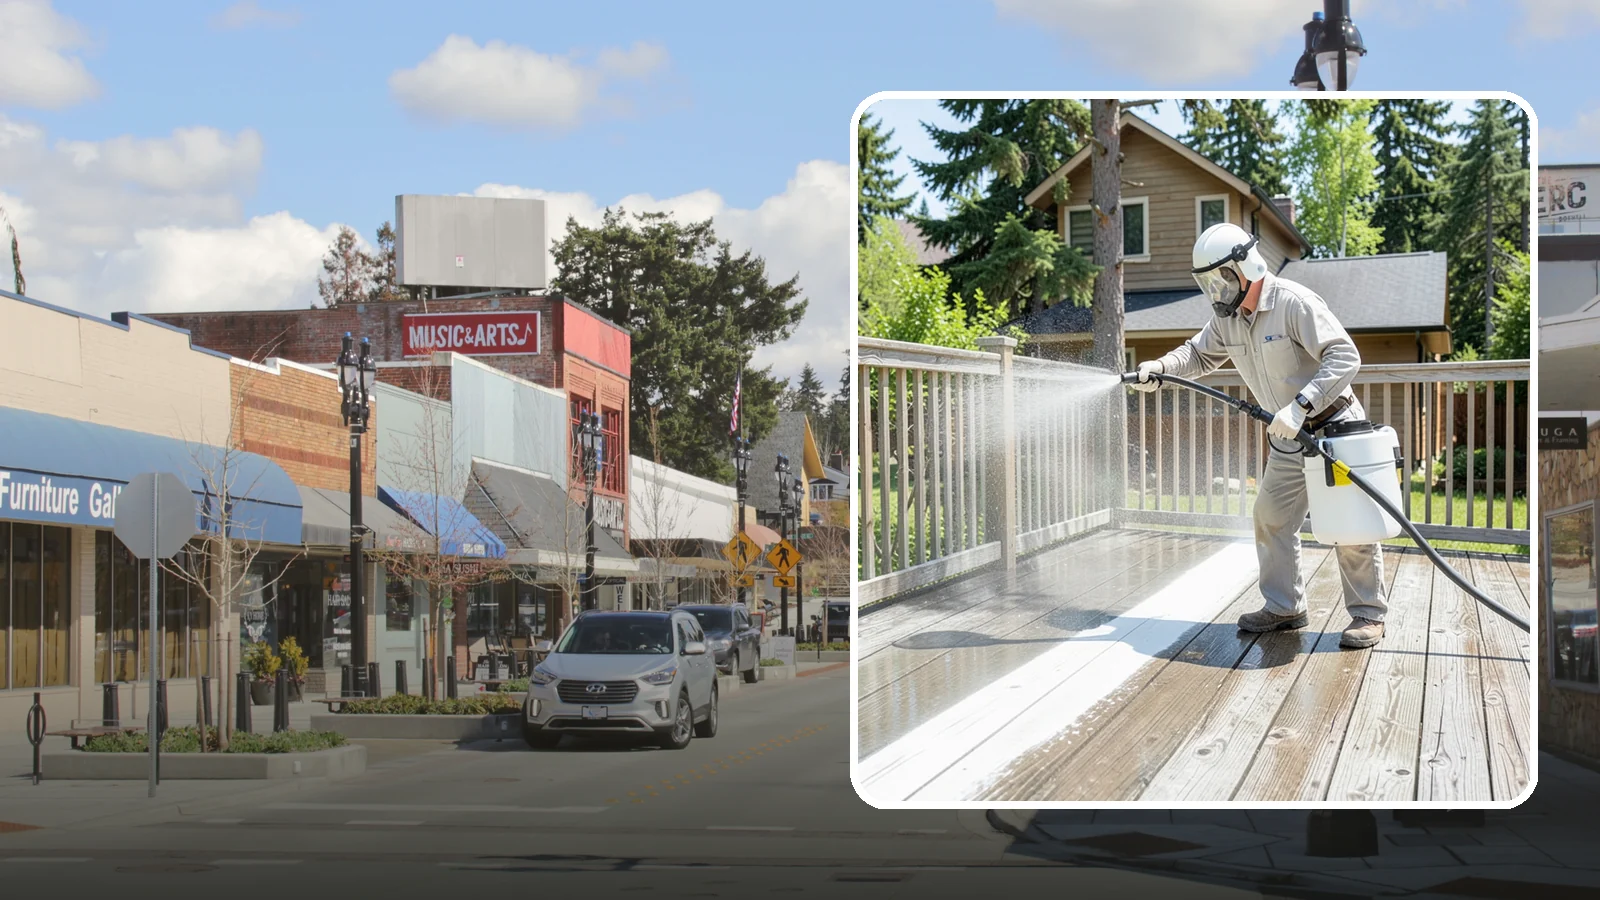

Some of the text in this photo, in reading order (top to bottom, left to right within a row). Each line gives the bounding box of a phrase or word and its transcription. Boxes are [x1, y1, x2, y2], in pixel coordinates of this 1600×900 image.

[408, 323, 519, 349] MUSIC&ARTS
[0, 471, 121, 519] Furniture Gal
